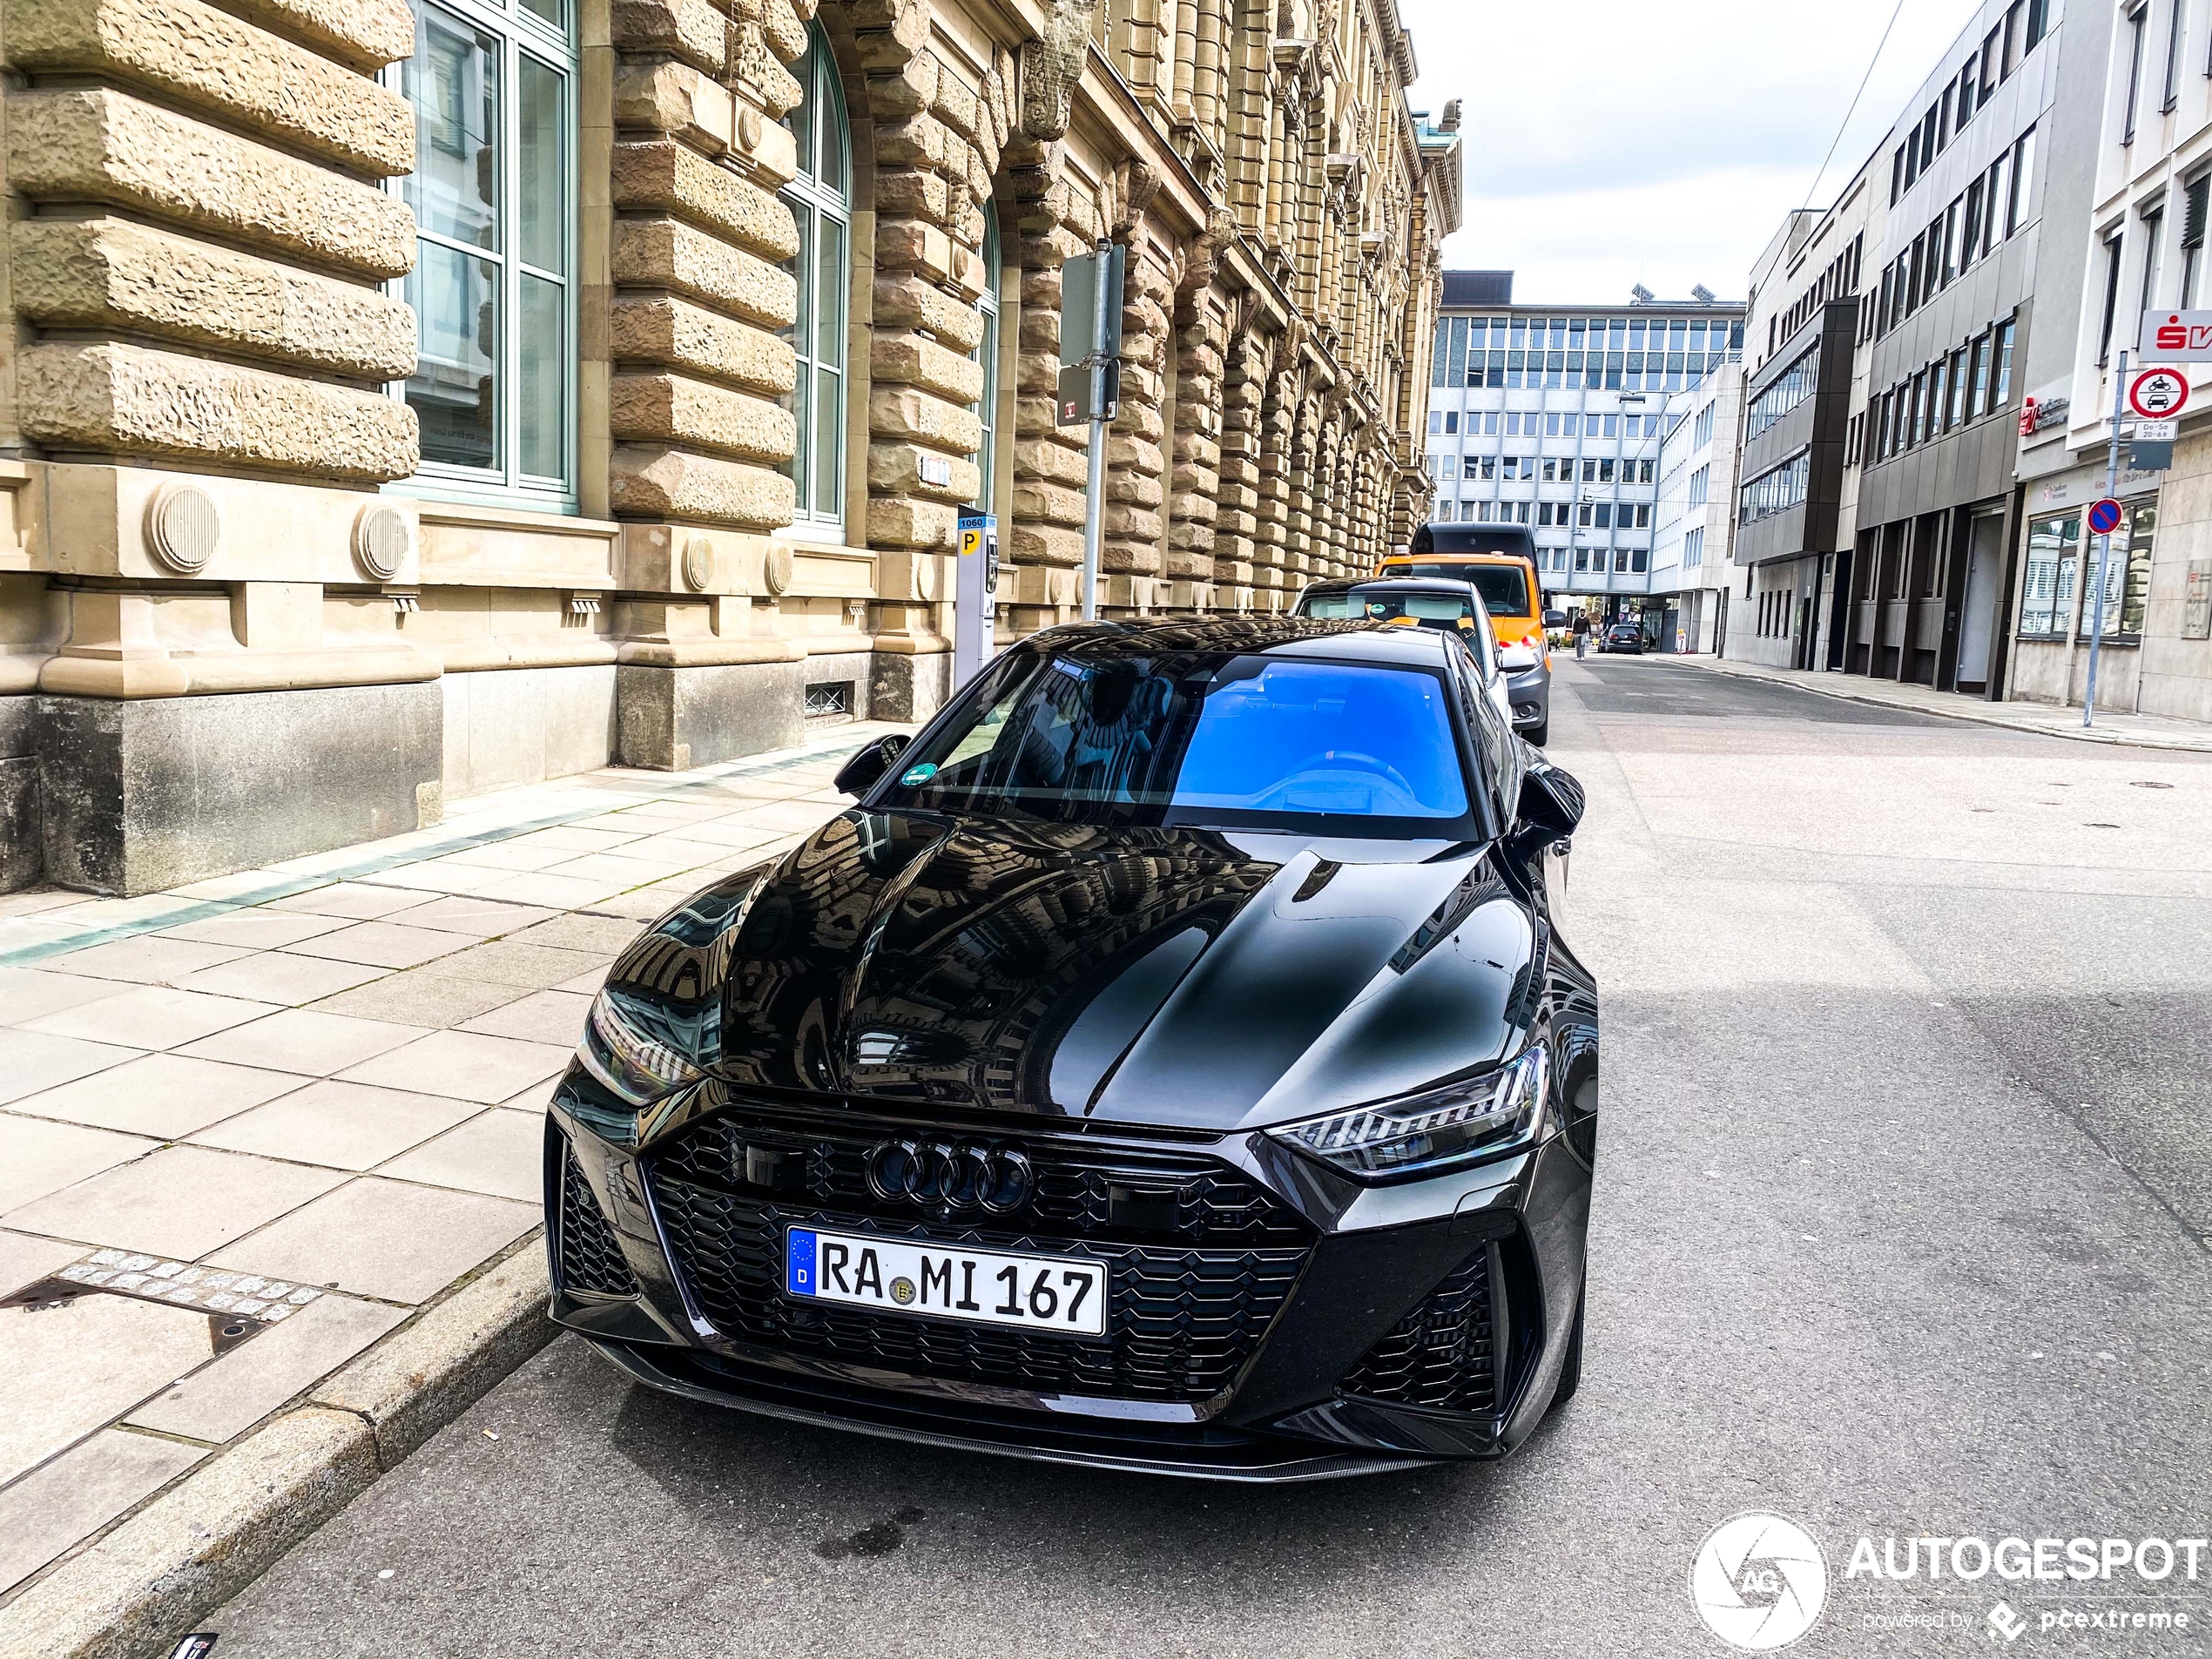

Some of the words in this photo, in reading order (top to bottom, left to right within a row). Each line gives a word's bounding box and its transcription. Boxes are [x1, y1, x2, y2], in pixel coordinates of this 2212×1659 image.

[961, 518, 982, 527] 1060
[965, 533, 974, 550] P
[798, 1269, 807, 1284] D
[822, 1242, 883, 1298] RA
[921, 1255, 980, 1312] MI
[995, 1265, 1093, 1322] 167
